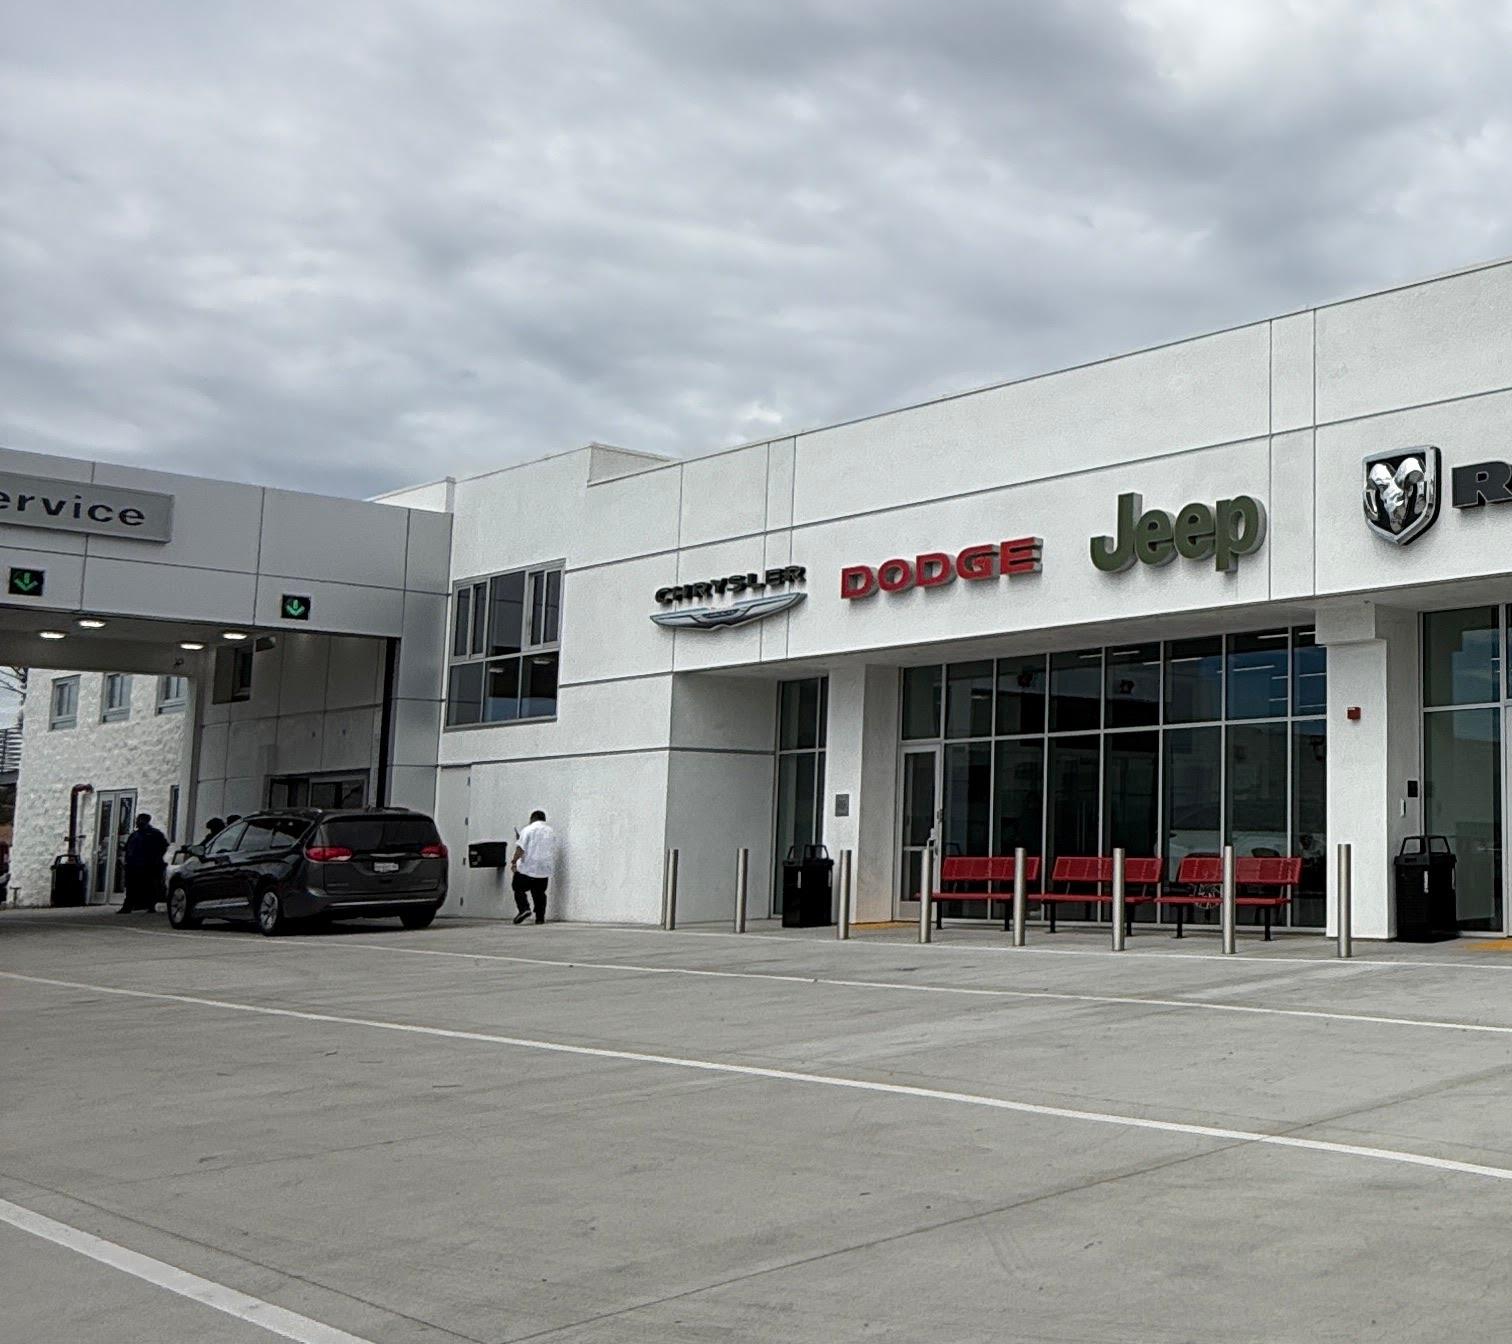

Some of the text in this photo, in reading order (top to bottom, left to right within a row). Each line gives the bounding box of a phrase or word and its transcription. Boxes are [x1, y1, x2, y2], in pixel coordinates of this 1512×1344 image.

[1089, 492, 1267, 573] Jeep
[655, 565, 807, 604] CHRYSLER
[840, 536, 1044, 600] DODGE
